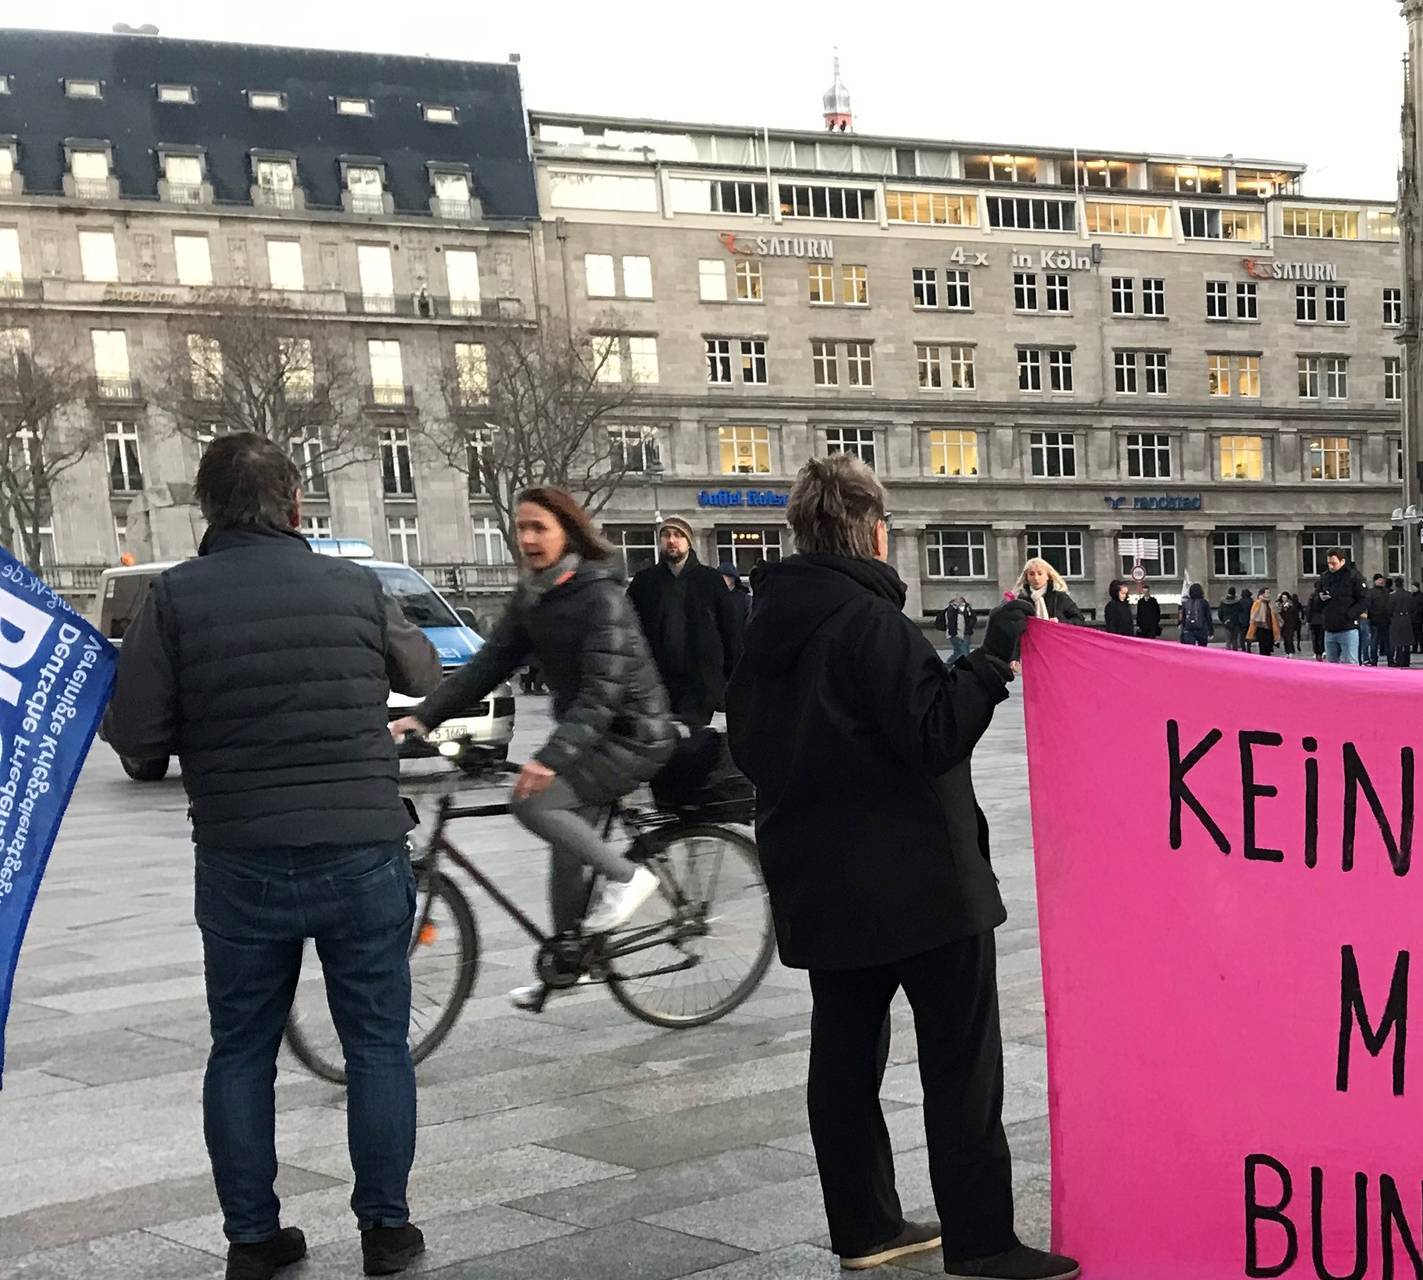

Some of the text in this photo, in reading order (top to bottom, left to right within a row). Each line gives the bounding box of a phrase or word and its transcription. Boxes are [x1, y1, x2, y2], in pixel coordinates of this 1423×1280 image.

[757, 235, 834, 259] SATURN
[950, 246, 1091, 270] 4 x in Köln
[1272, 260, 1338, 281] SATURN
